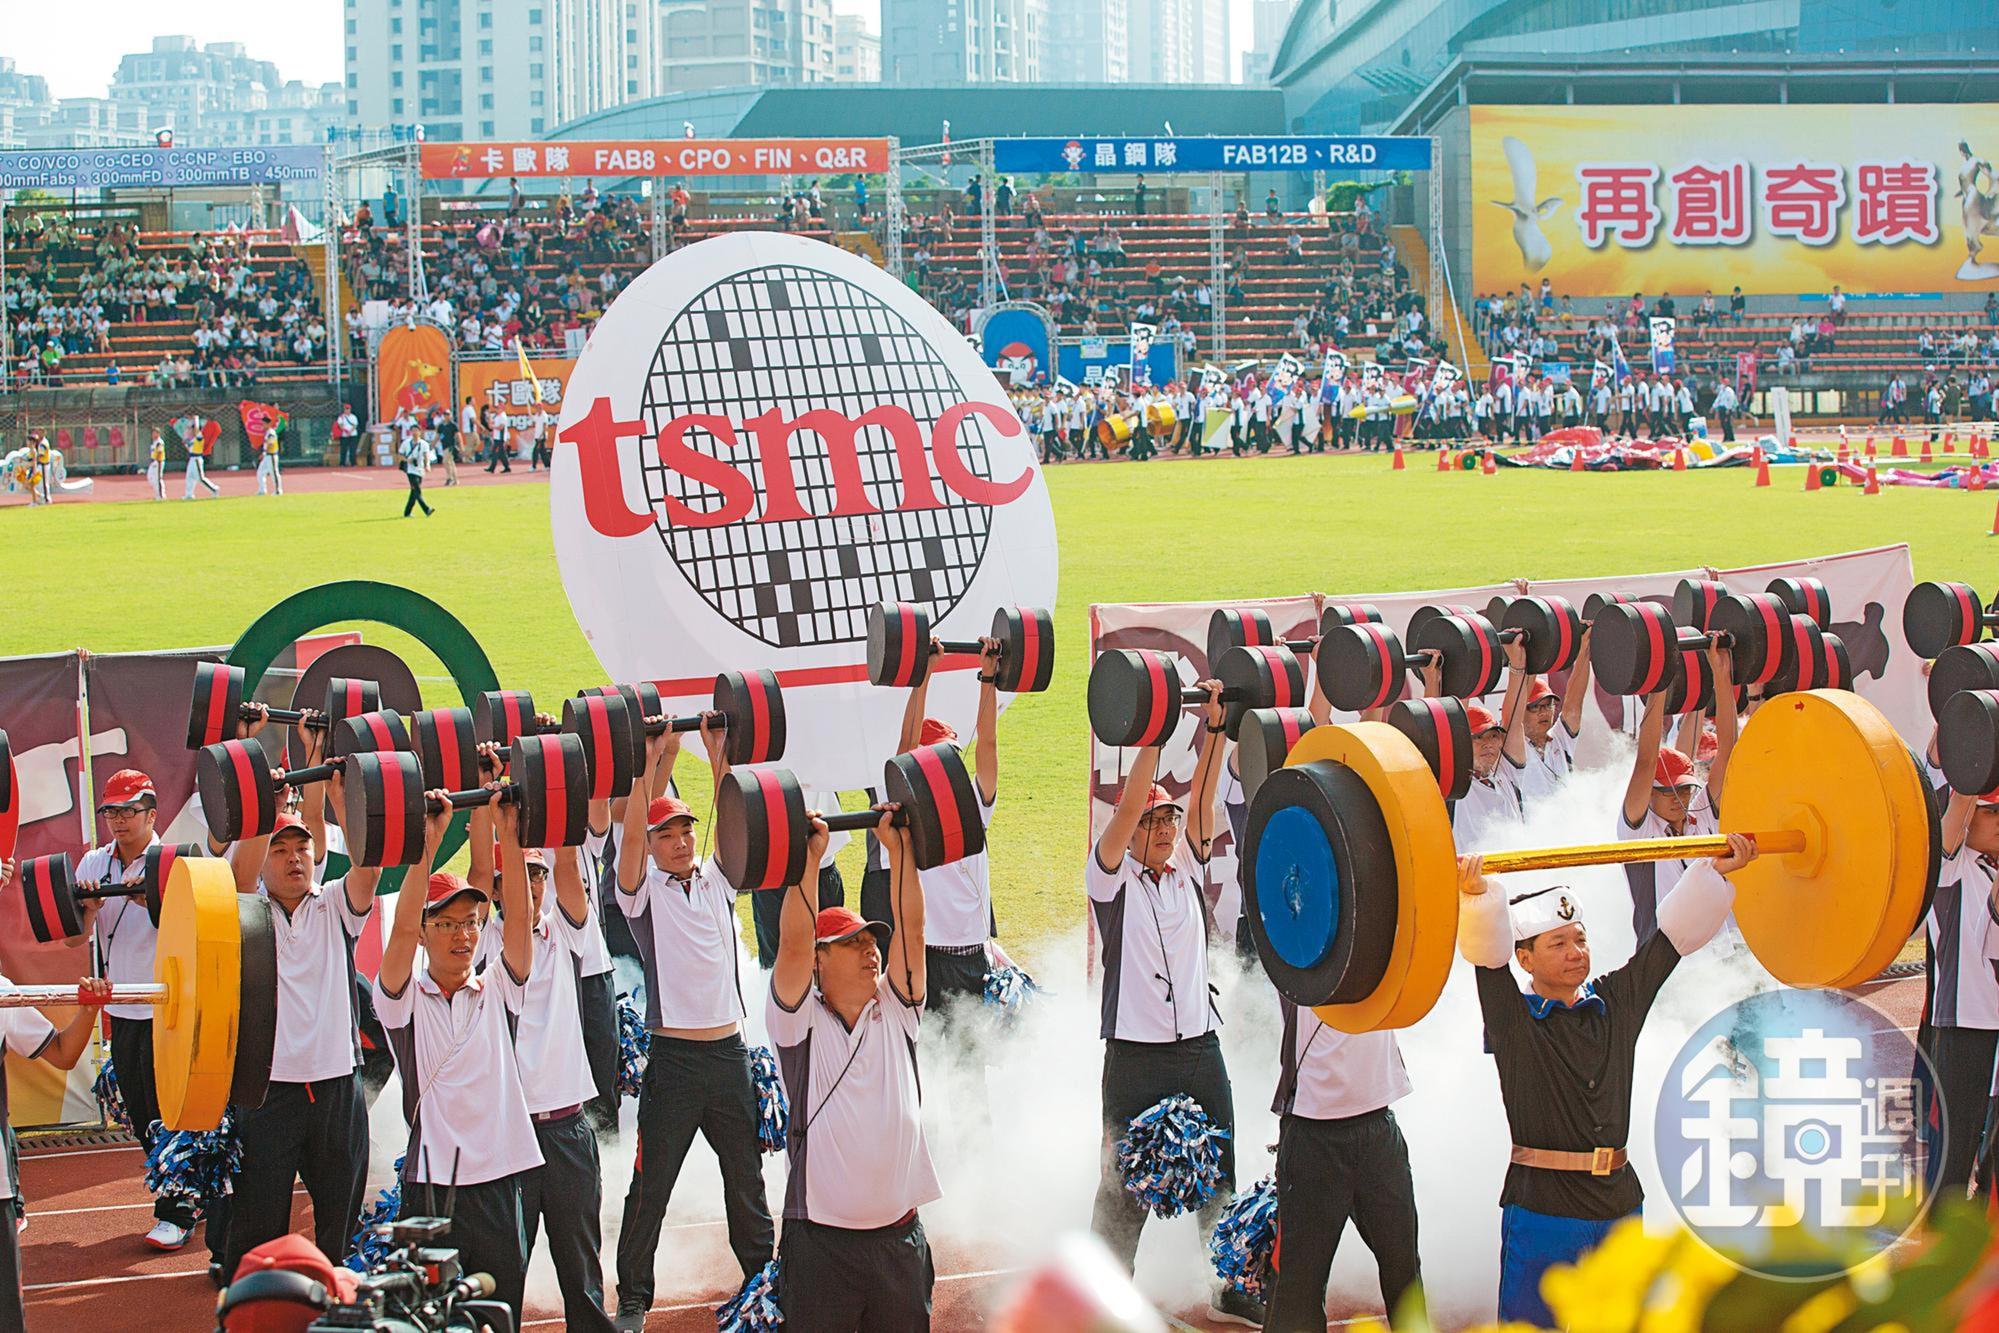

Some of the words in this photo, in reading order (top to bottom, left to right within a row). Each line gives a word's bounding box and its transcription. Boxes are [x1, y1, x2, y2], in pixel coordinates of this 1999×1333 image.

[480, 146, 570, 173] 卡歐隊
[815, 147, 867, 169] Q&R
[1094, 142, 1177, 167] 晶鋼隊
[1329, 144, 1376, 164] R&D
[265, 165, 318, 179] 450mm
[1578, 160, 1935, 243] 再創奇蹟
[558, 396, 1034, 537] tsmc
